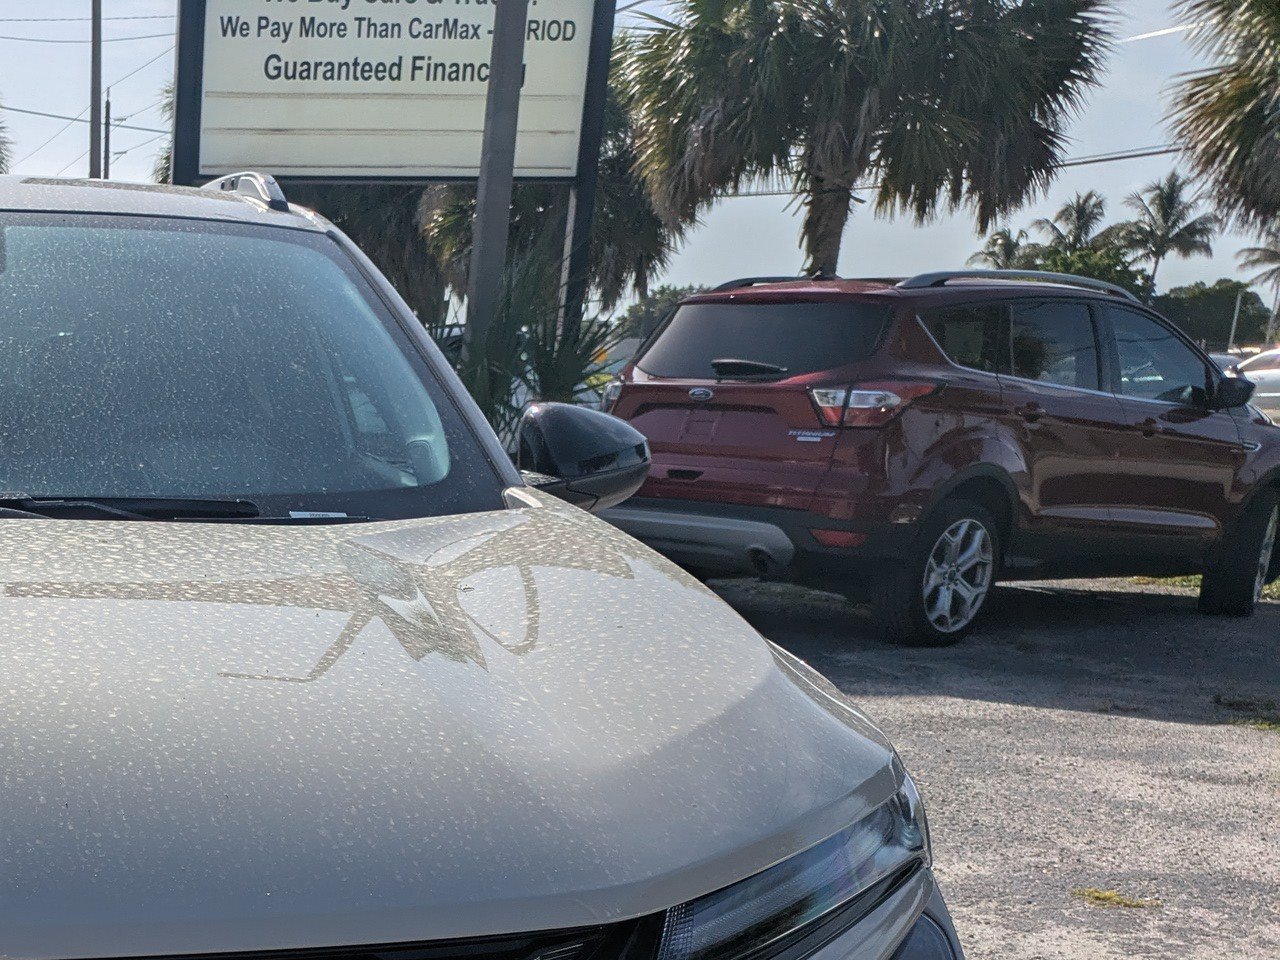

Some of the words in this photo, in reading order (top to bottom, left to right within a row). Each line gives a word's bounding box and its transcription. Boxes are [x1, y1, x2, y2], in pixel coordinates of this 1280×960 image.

[220, 16, 250, 38] We
[257, 16, 293, 43] Pay
[299, 16, 348, 38] More
[354, 17, 402, 39] Than
[408, 18, 481, 40] CarMax
[526, 19, 576, 42] RIOD
[263, 54, 402, 82] Guaranteed
[411, 56, 526, 89] Financ
